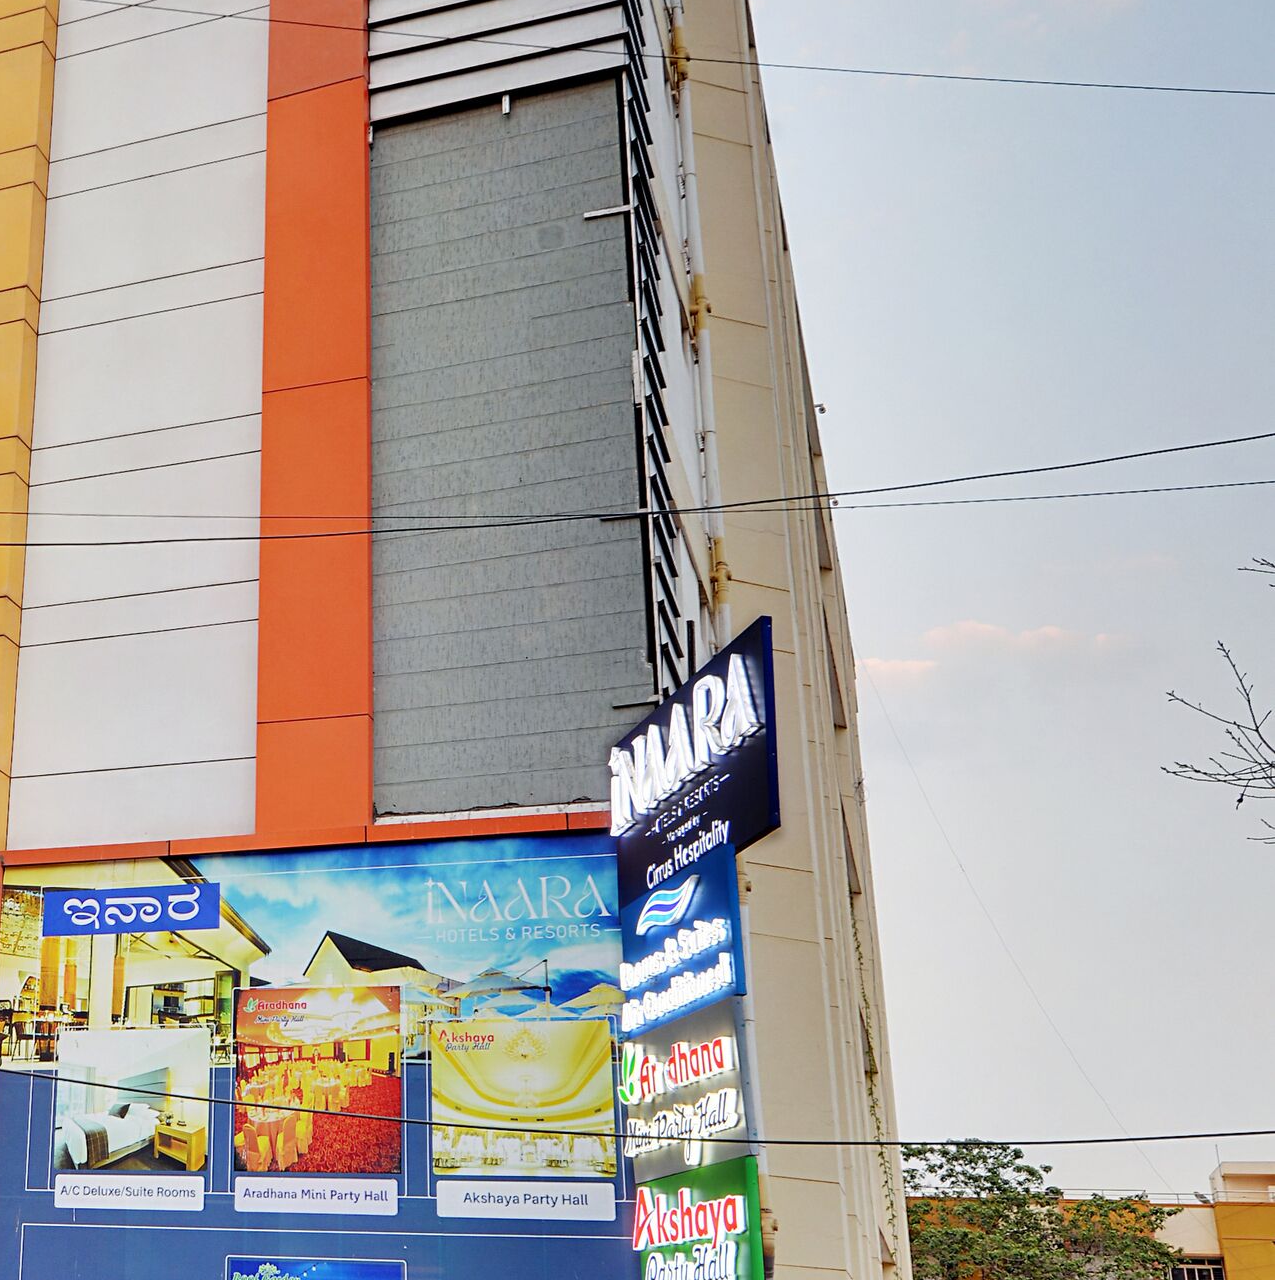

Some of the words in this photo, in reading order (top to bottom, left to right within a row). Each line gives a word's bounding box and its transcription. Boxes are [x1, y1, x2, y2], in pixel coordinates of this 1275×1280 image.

[646, 858, 674, 890] Cirrus
[673, 819, 731, 871] Hospitality
[435, 927, 500, 943] HOTELS
[505, 927, 516, 941] &
[521, 923, 601, 939] RESORTS
[257, 1000, 307, 1010] Aradhana
[438, 1029, 495, 1043] Akshaya
[639, 1037, 732, 1102] Ardhana
[654, 1105, 695, 1163] Party
[695, 1090, 734, 1135] Hall
[60, 1185, 80, 1196] A/C
[83, 1185, 154, 1197] Deluxe/Suite
[157, 1187, 196, 1198] Rooms
[243, 1188, 297, 1200] Aradhana
[301, 1189, 326, 1200] Mini
[330, 1190, 361, 1204] Party
[364, 1190, 388, 1202] Hall
[463, 1192, 520, 1207] Akshaya
[523, 1193, 558, 1208] Party
[562, 1194, 588, 1206] Hall
[633, 1187, 741, 1250] Akshaya
